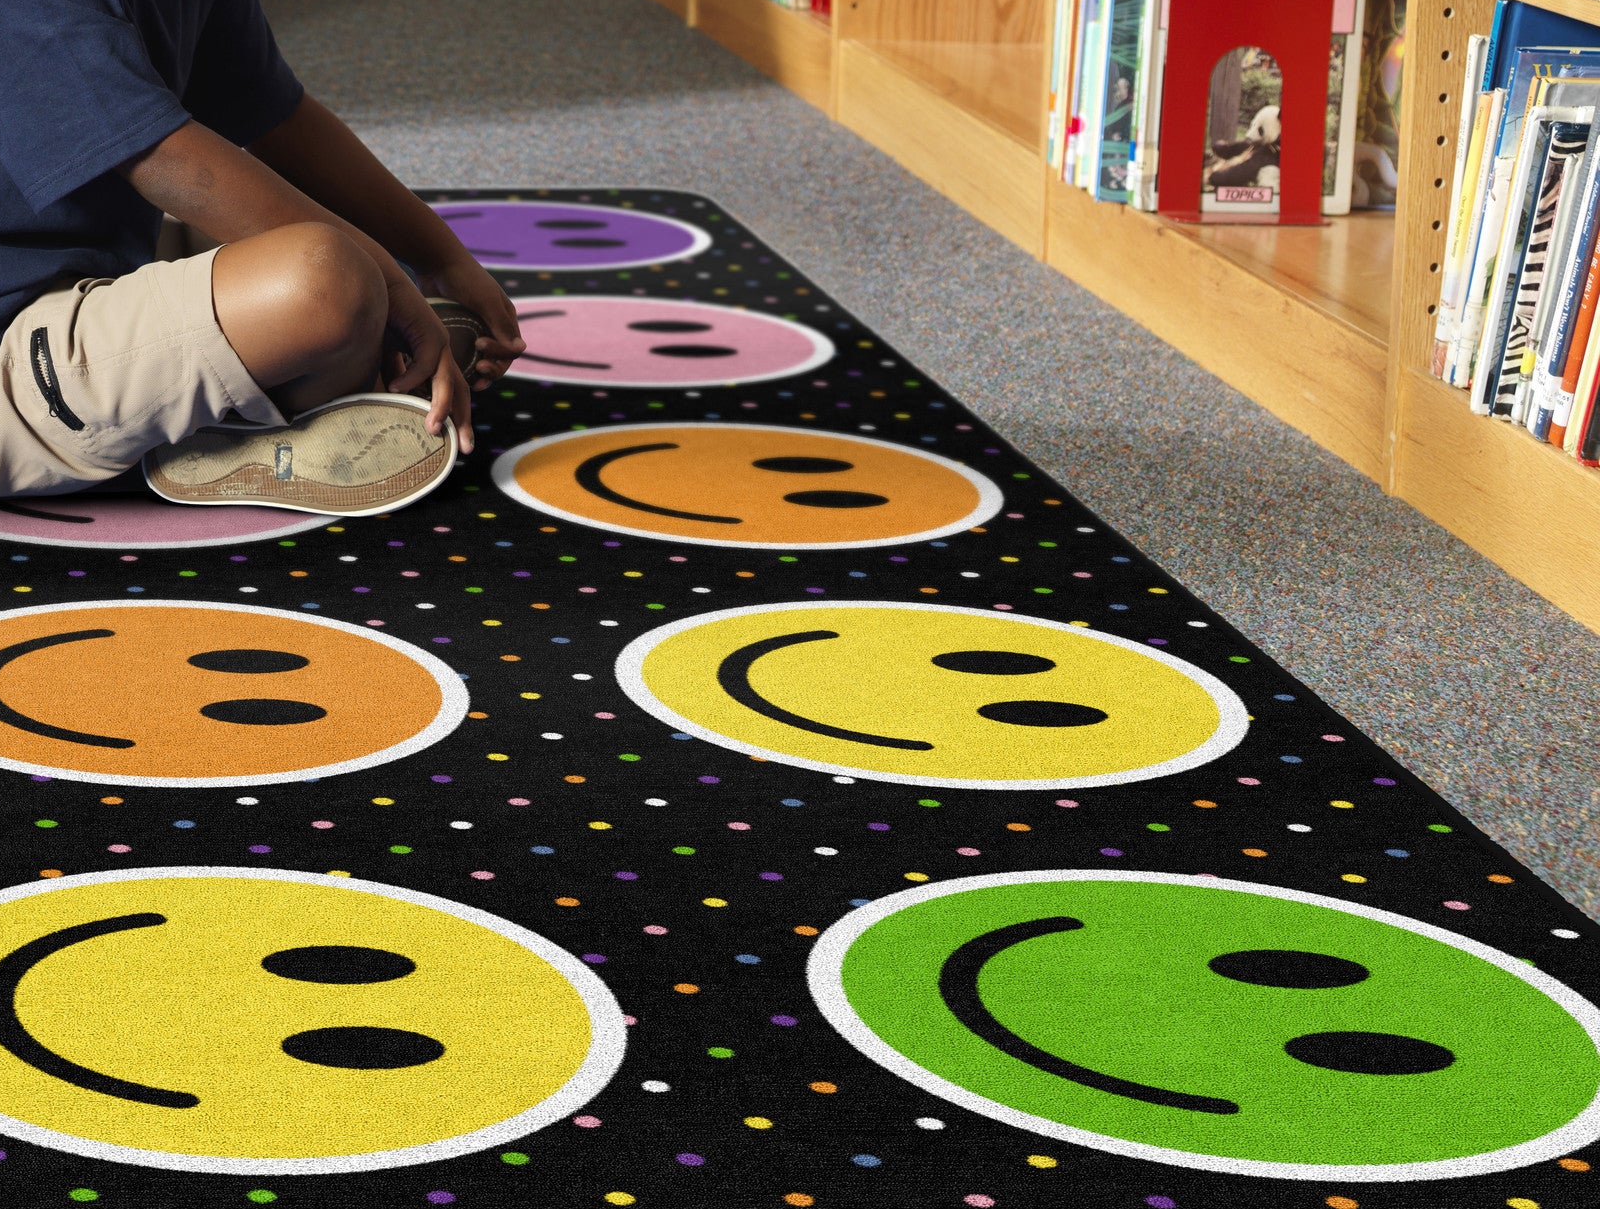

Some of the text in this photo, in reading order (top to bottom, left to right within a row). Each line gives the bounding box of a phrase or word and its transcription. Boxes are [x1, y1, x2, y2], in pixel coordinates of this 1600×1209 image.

[1482, 39, 1495, 83] ANIMALS
[1224, 188, 1266, 200] TOPICS
[1591, 258, 1598, 270] BE
[1583, 273, 1595, 301] EARLY
[1551, 256, 1582, 362] Animals Don't Wear Pajamas
